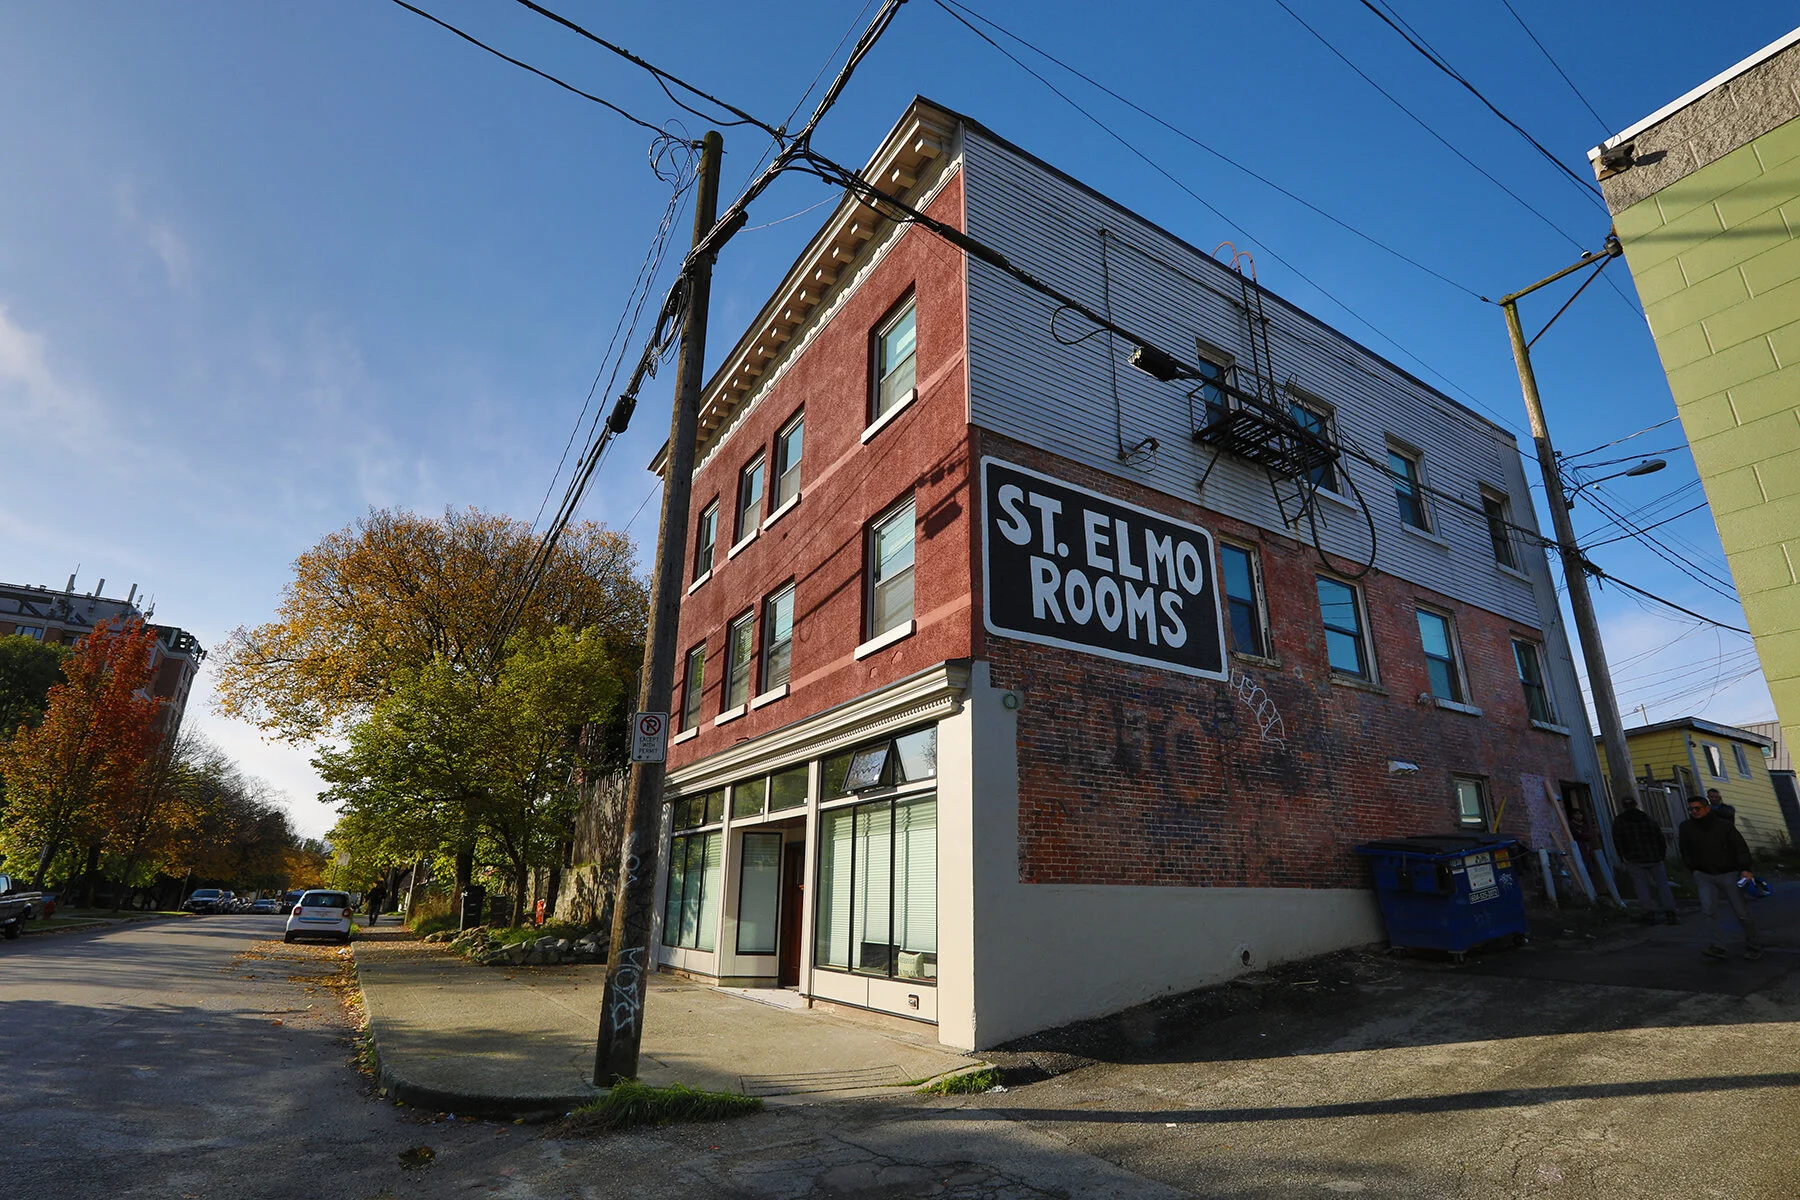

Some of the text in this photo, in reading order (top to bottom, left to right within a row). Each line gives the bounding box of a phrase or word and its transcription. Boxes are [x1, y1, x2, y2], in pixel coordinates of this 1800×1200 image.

[996, 484, 1204, 596] ST. ELMO
[1030, 555, 1188, 649] ROOMS
